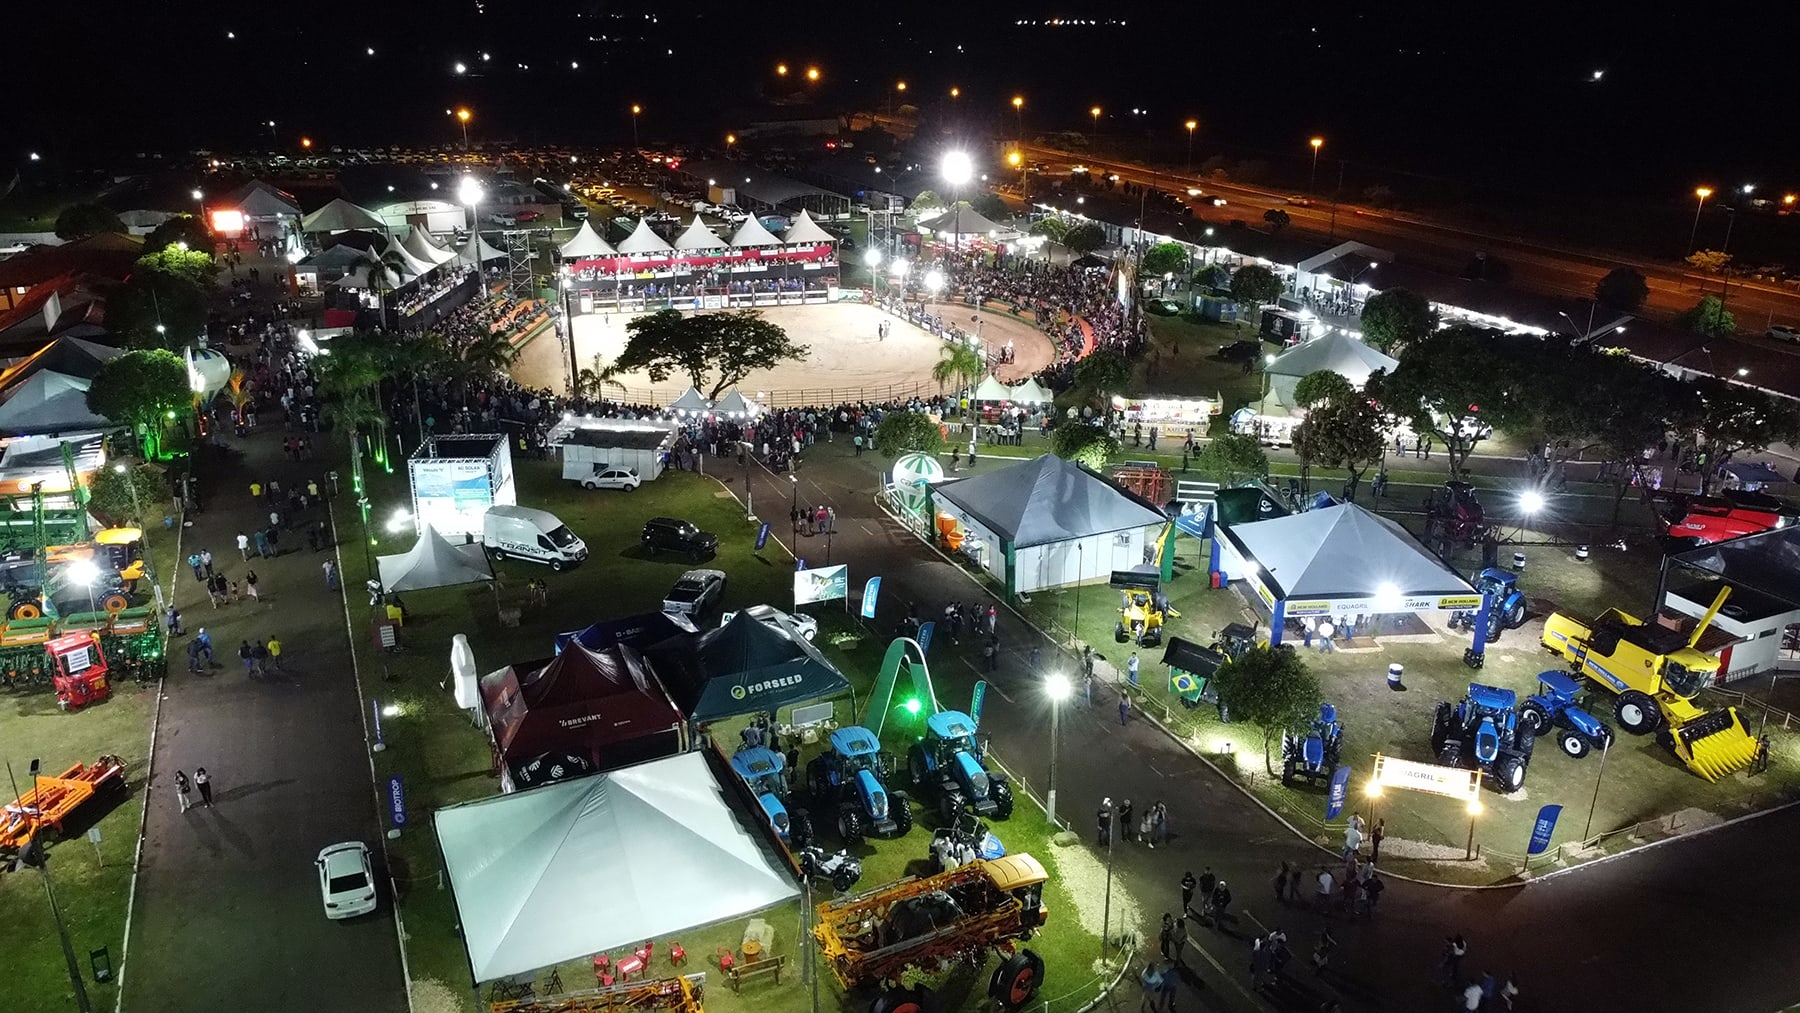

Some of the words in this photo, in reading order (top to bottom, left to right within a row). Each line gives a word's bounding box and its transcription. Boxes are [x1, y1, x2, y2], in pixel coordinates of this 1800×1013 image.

[500, 541, 549, 555] TRANSIT
[1336, 603, 1369, 611] EQUAGRIL
[747, 674, 803, 695] FORSEED
[567, 713, 602, 726] BREVANT
[391, 779, 402, 812] BIOTROP
